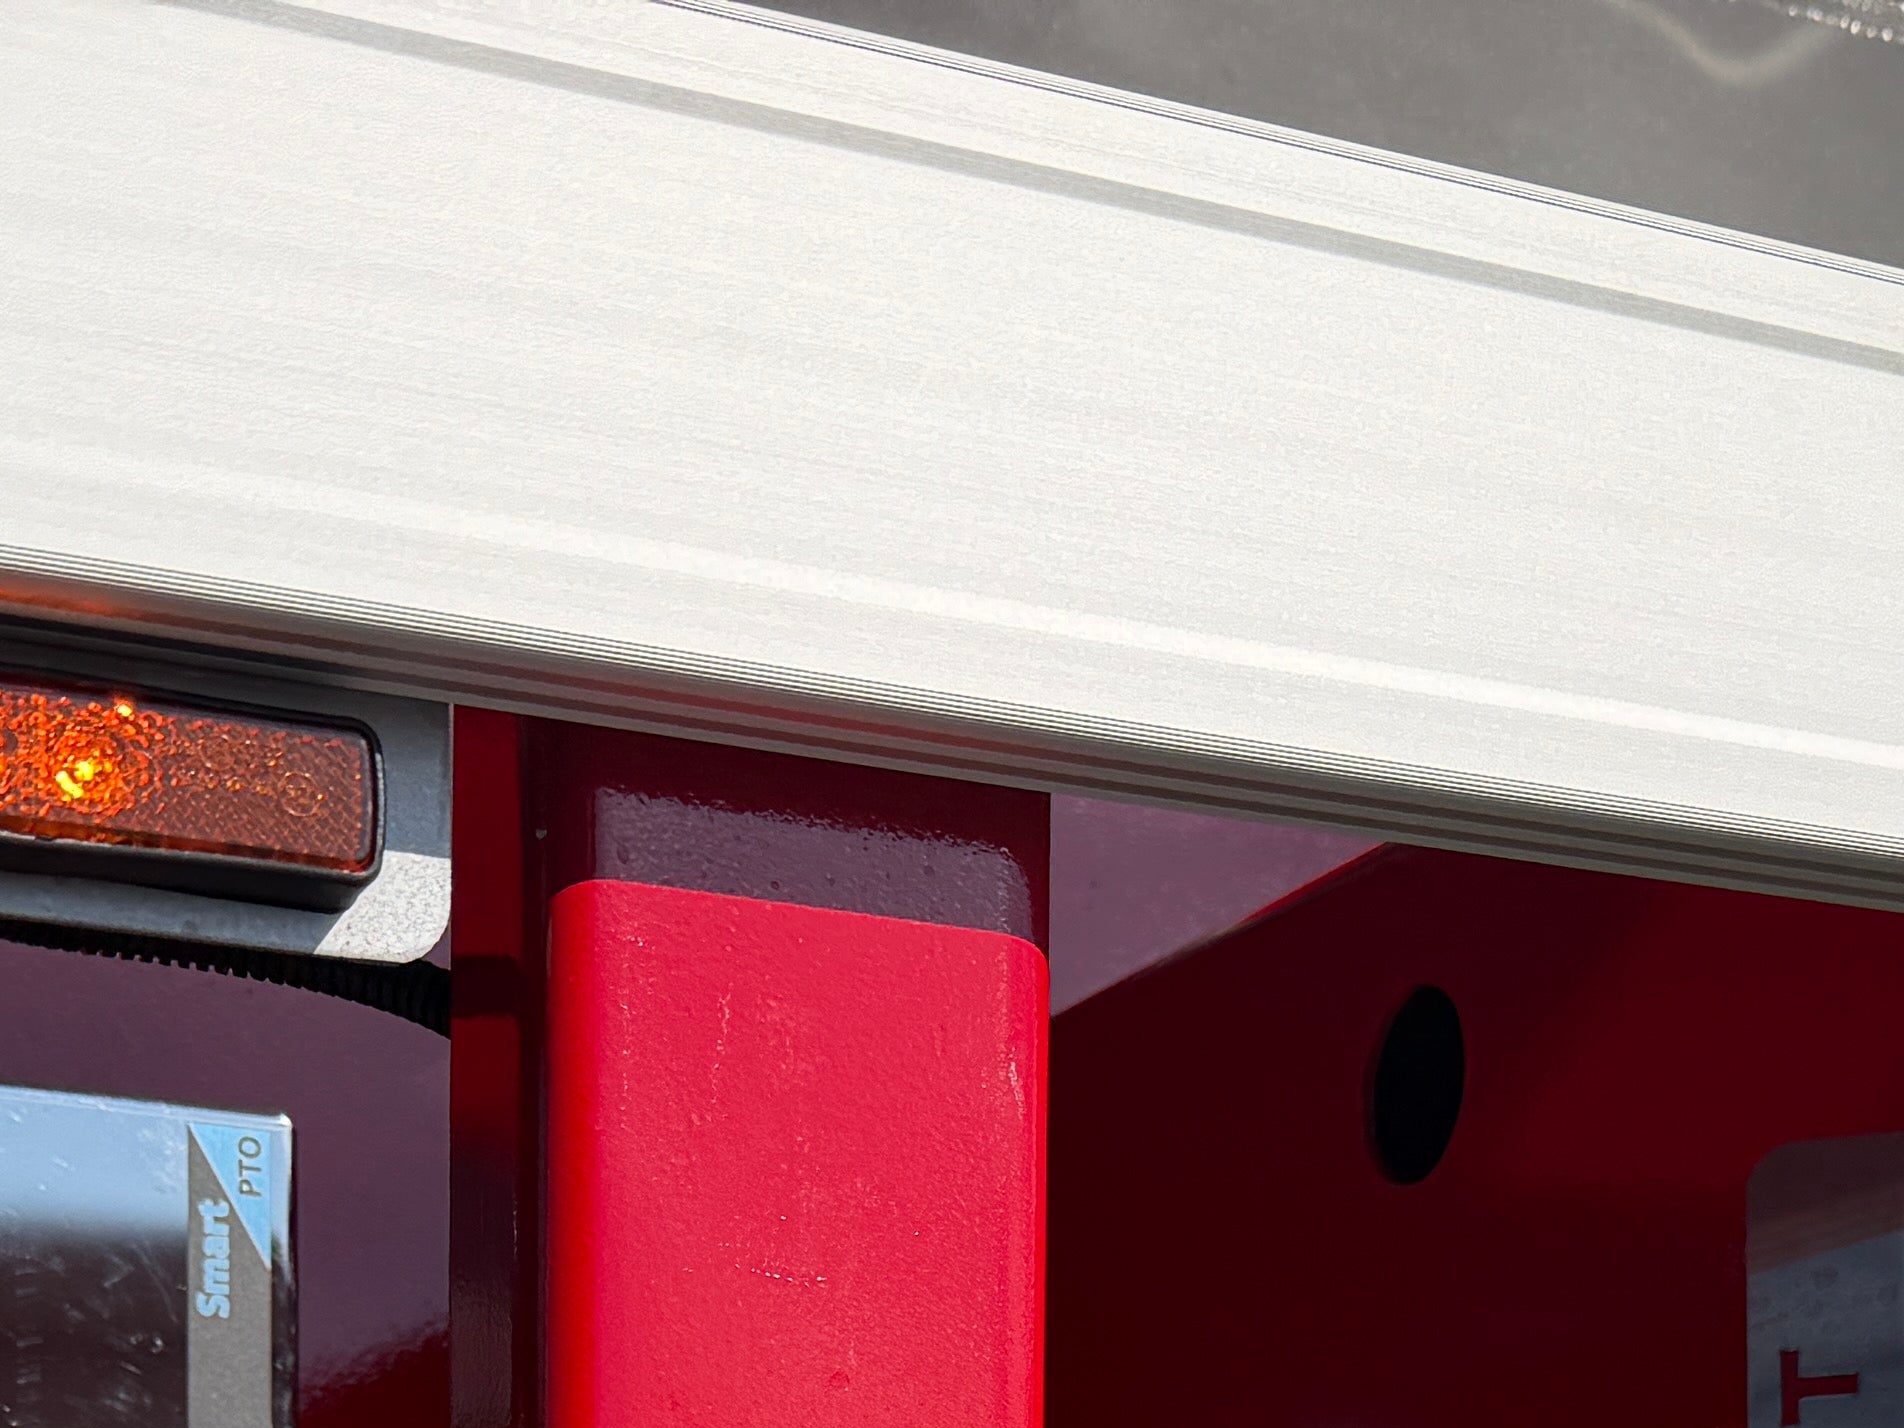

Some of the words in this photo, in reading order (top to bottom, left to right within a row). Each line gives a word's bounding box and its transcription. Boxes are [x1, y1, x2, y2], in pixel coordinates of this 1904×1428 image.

[238, 1136, 262, 1197] PTO
[196, 1198, 230, 1319] Smart
[1780, 1349, 1859, 1427] T
